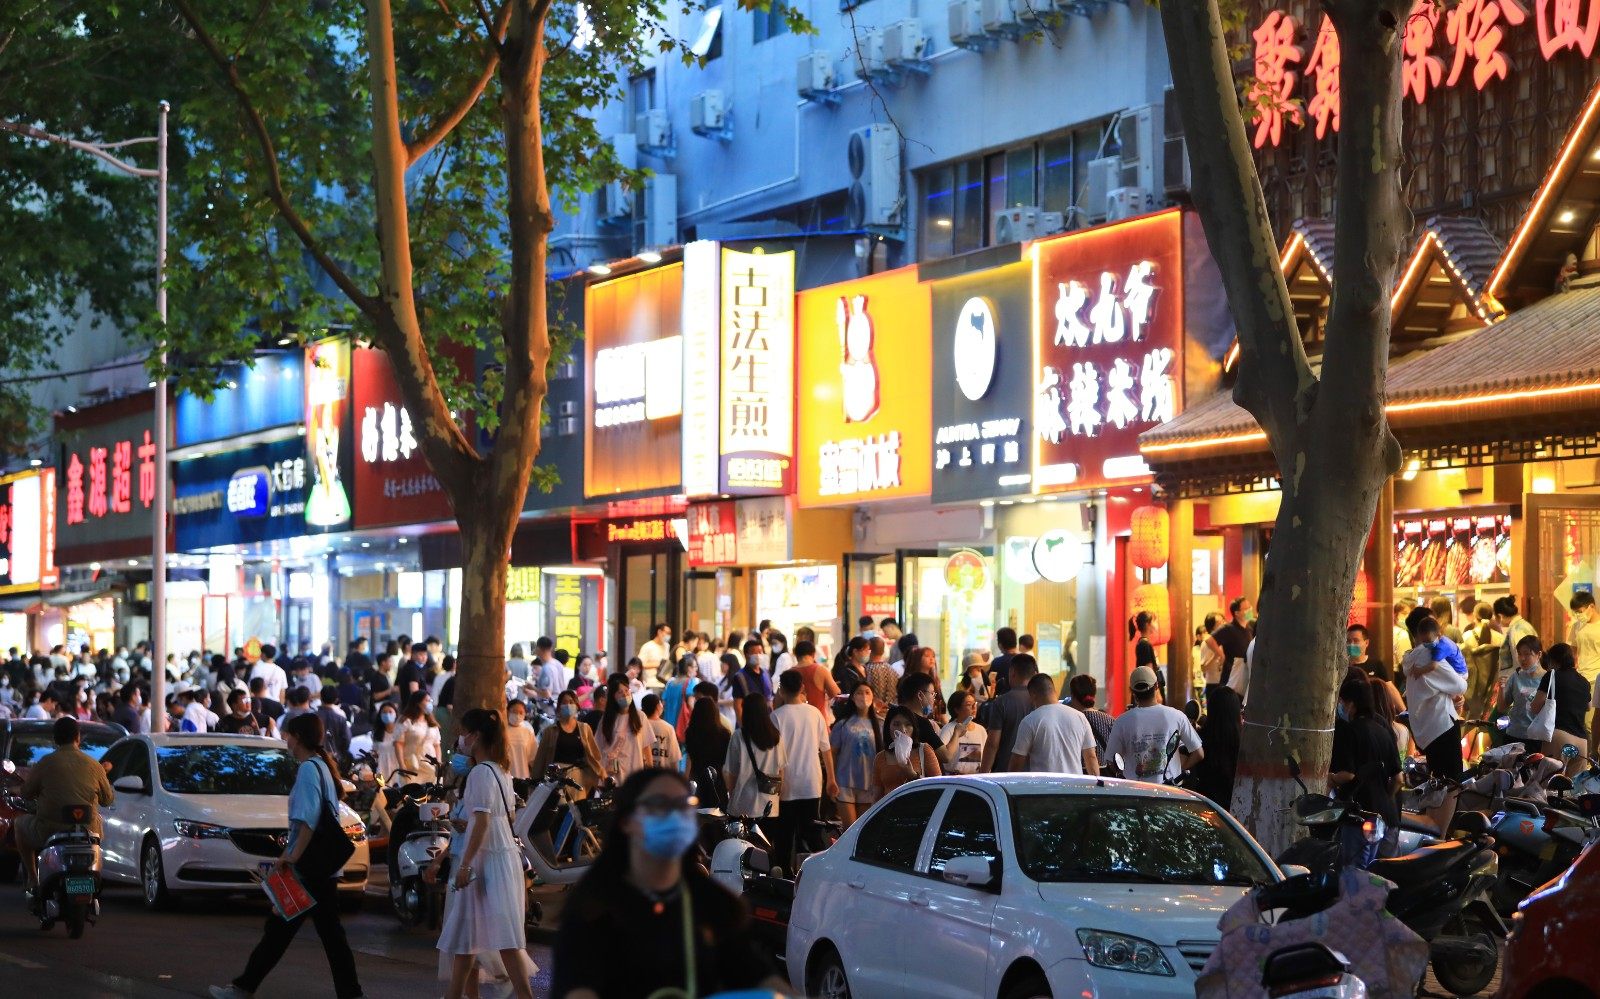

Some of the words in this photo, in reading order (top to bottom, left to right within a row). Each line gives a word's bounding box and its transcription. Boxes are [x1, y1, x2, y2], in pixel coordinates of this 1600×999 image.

[731, 267, 768, 437] 古法生煎
[67, 430, 156, 526] 鑫源超市
